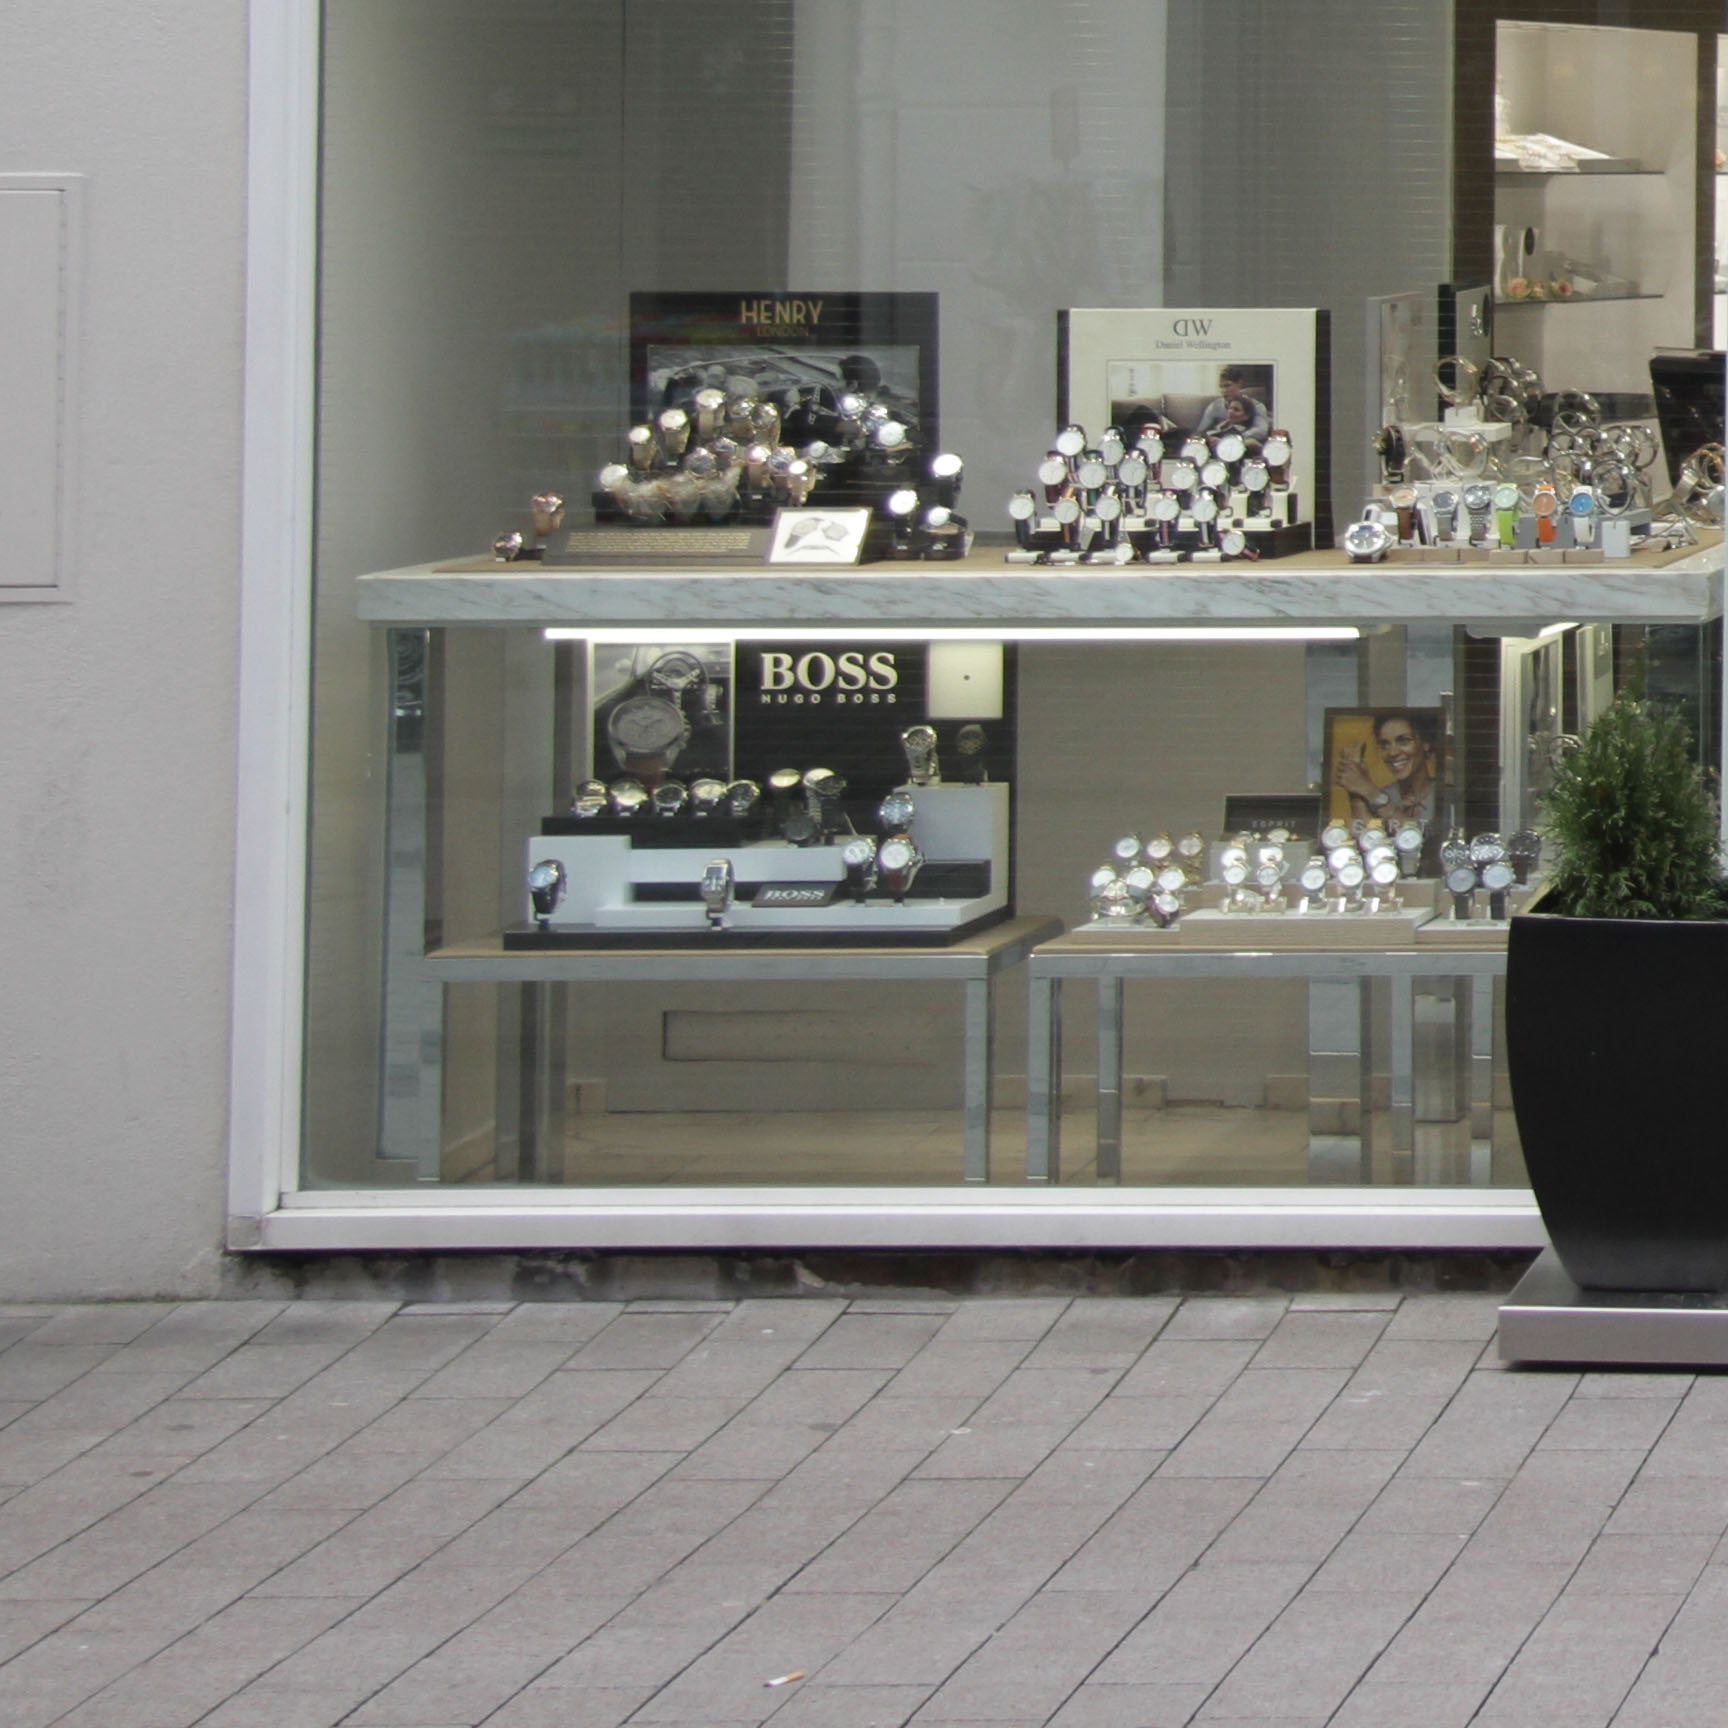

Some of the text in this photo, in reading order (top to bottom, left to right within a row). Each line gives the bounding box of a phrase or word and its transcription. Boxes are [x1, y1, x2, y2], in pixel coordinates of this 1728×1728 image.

[741, 300, 823, 325] HENRY
[1186, 339, 1232, 352] Wellington
[760, 652, 899, 692] BOSS
[761, 693, 898, 704] HUGO BOSS
[763, 888, 826, 903] BOSS
